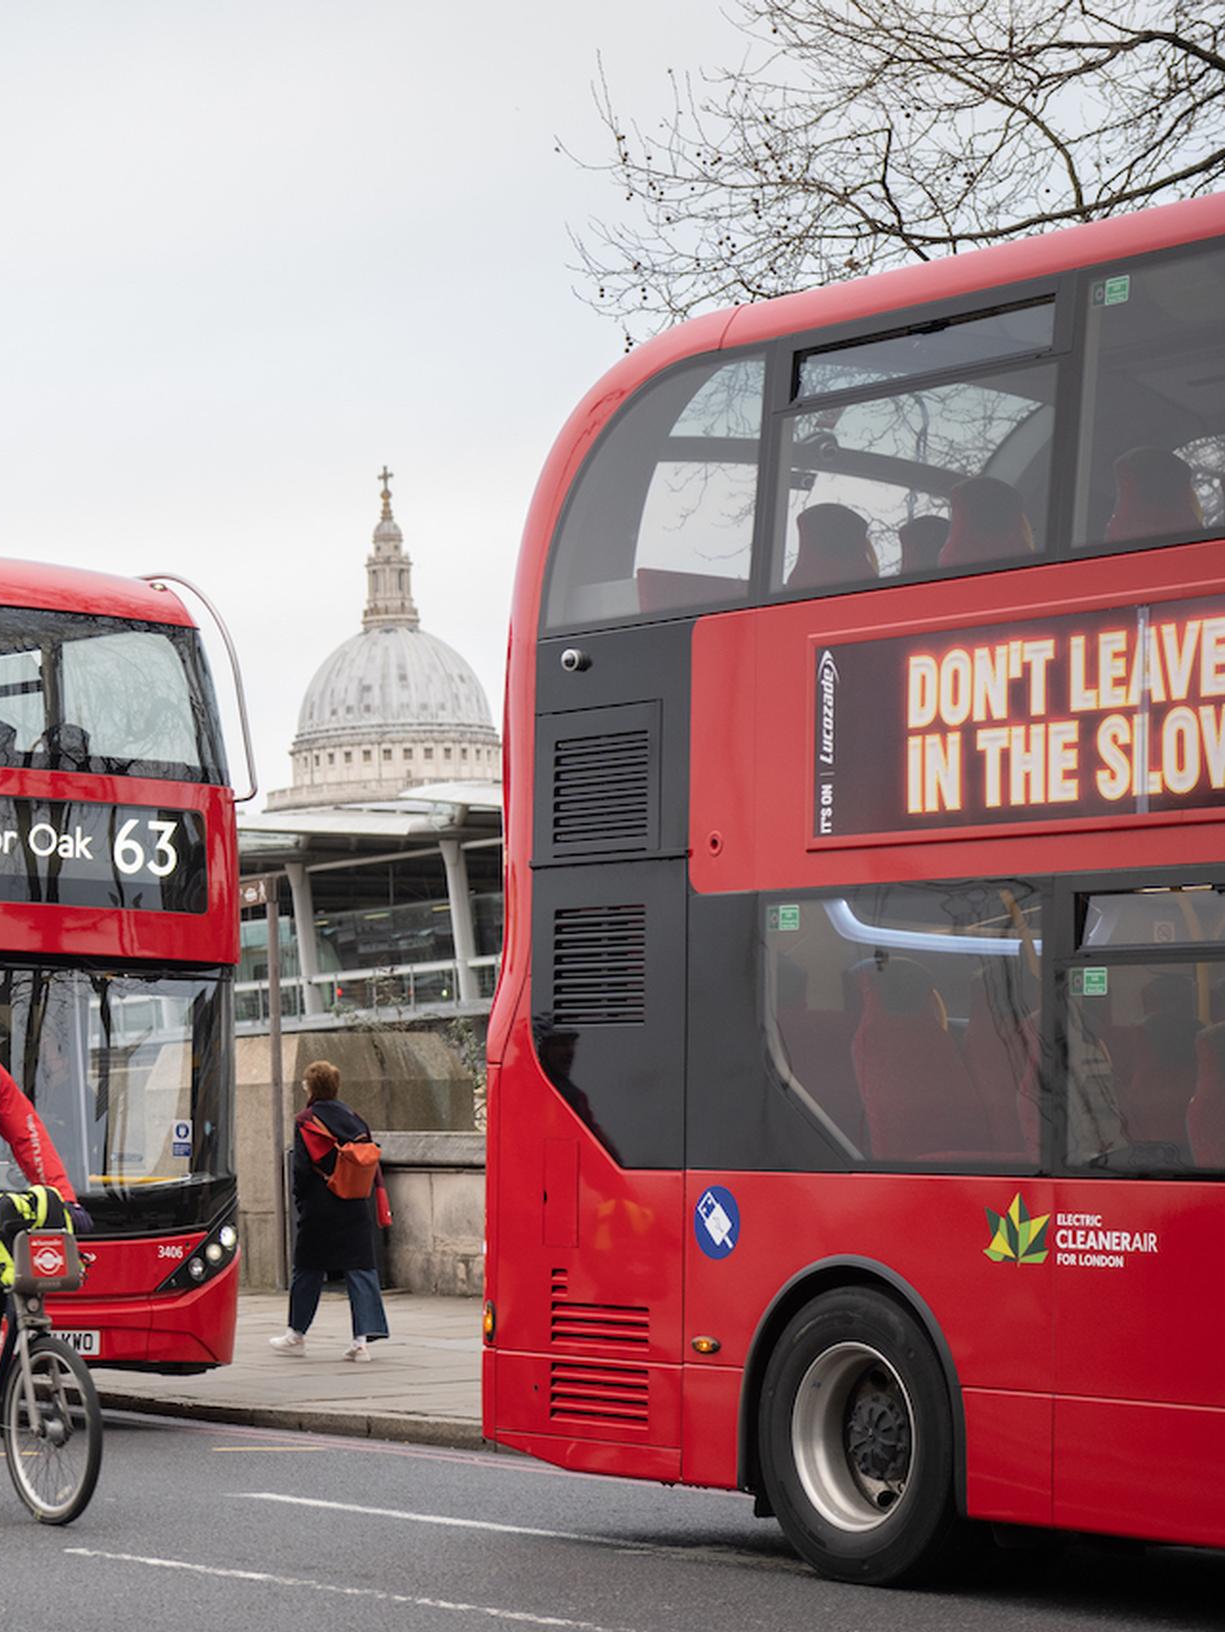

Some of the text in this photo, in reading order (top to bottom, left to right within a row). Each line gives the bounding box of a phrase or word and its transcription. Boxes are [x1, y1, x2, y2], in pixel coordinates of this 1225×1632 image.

[907, 617, 1225, 729] DON'T LEAVE
[819, 667, 836, 764] Lucozade
[907, 730, 962, 814] IN
[976, 719, 1079, 808] THE
[820, 784, 833, 805] ON
[28, 823, 94, 860] Oak
[113, 818, 177, 877] 63
[1057, 1213, 1103, 1227] ELECTRIC
[157, 1245, 184, 1259] 3406
[1056, 1254, 1124, 1267] FOR LONDON
